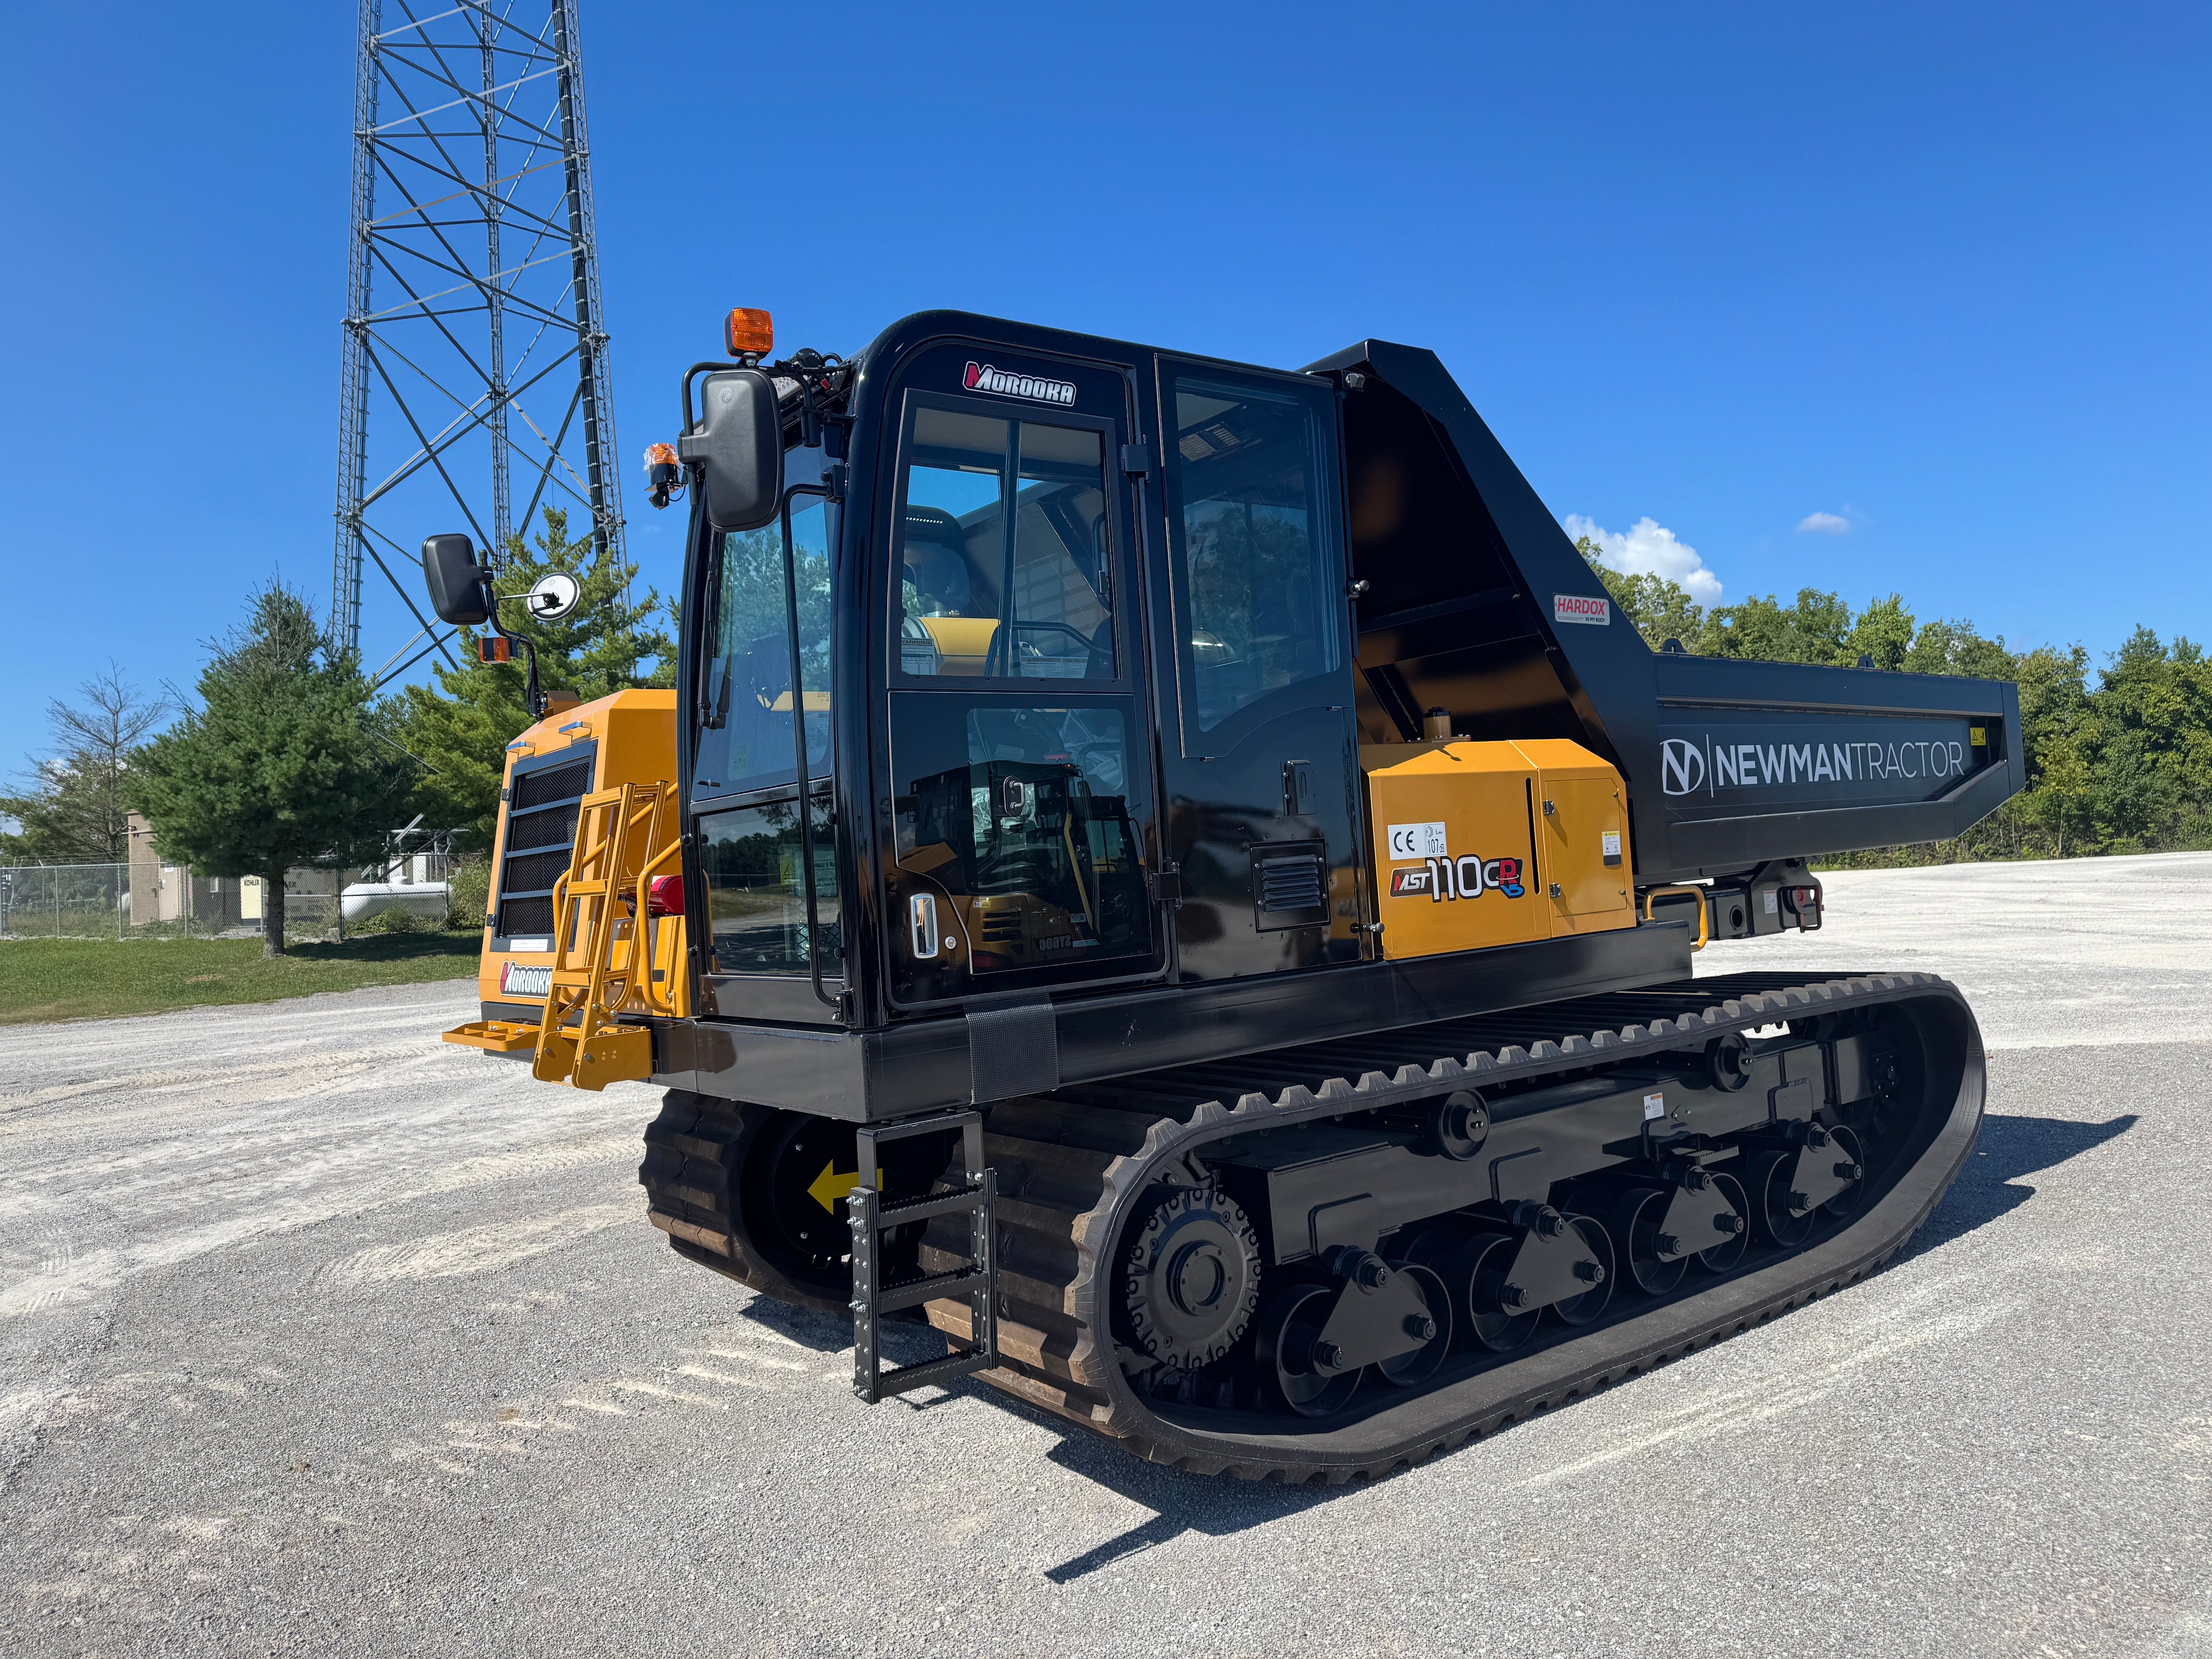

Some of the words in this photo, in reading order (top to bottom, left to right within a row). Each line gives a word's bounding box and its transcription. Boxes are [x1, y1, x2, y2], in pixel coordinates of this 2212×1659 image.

[965, 364, 1074, 403] MOROOKA
[1557, 598, 1605, 616] HARDOX
[1394, 831, 1415, 852] CE
[1428, 838, 1439, 854] 107
[500, 962, 553, 994] MOROOKA
